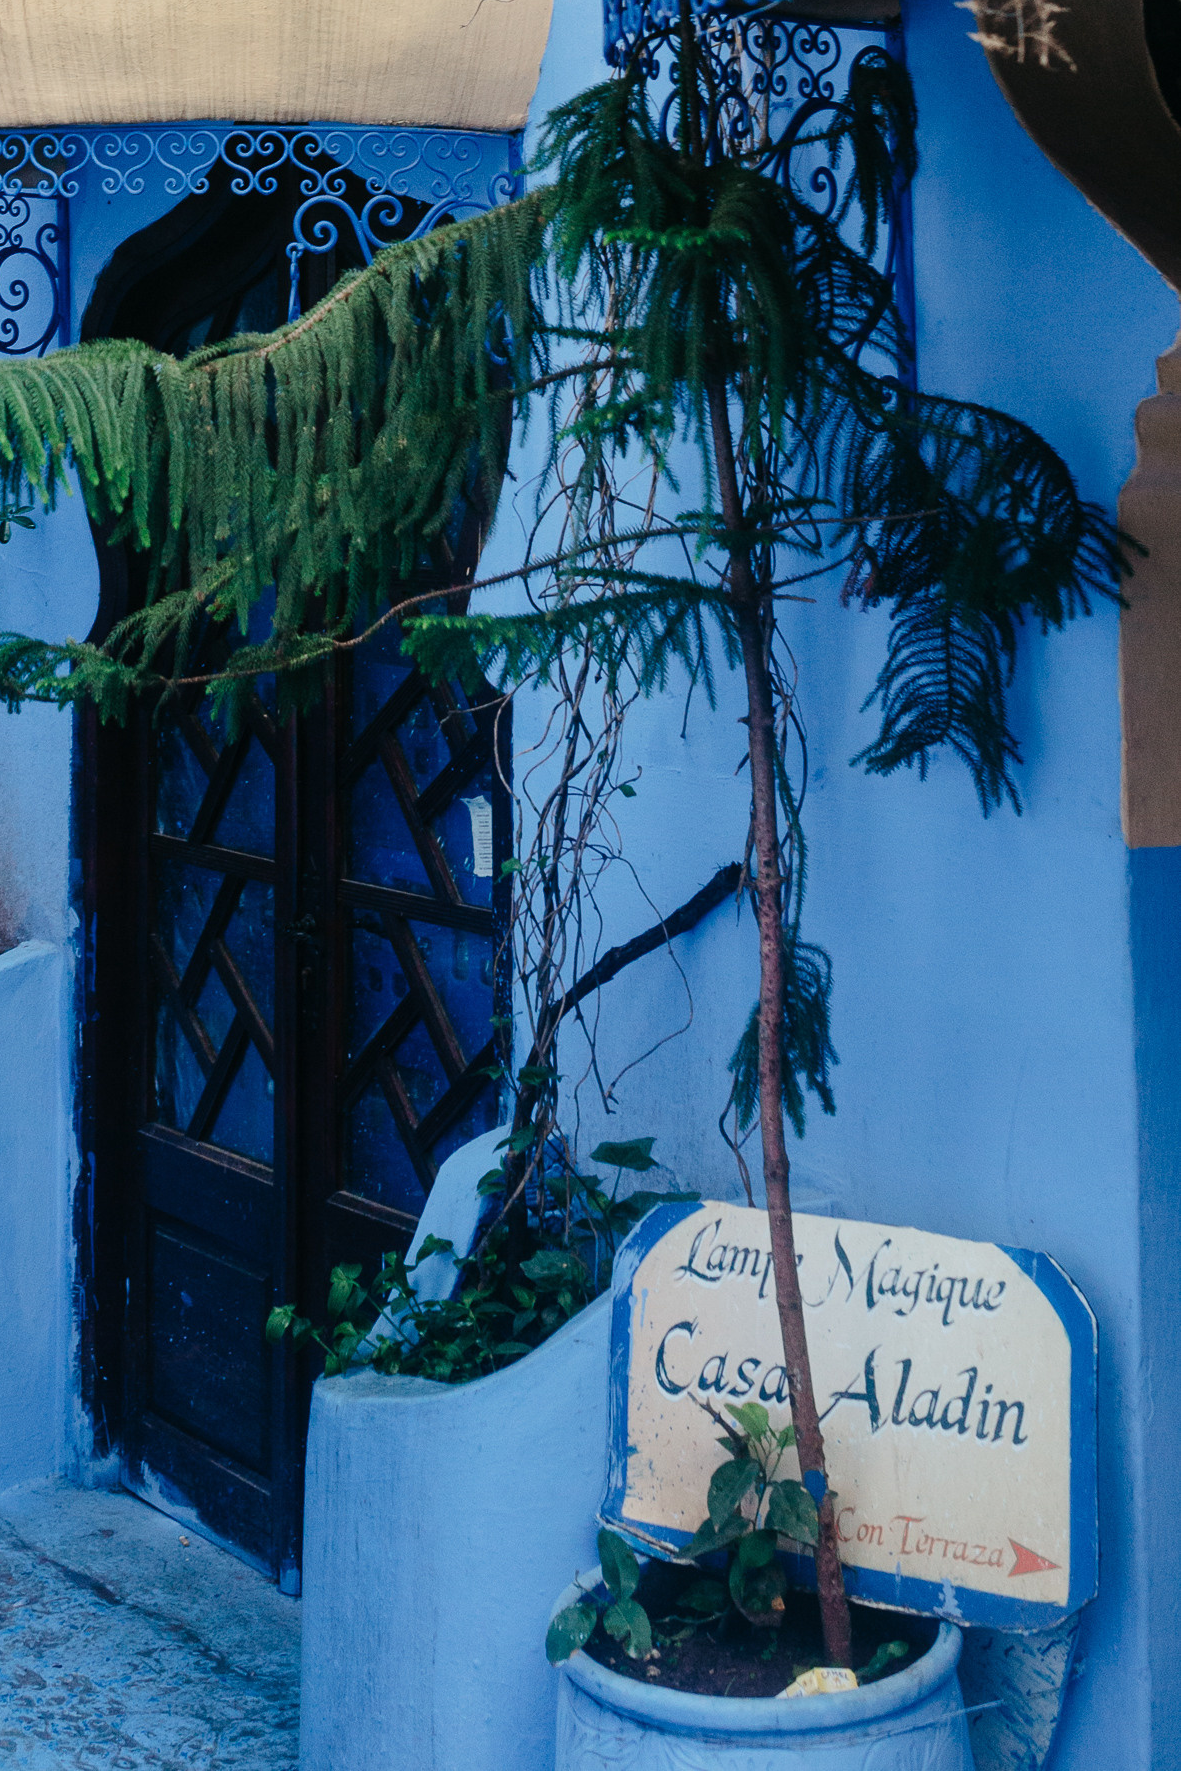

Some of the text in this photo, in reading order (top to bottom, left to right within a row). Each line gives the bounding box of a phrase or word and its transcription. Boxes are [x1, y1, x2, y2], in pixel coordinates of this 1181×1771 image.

[803, 1224, 1006, 1327] Magique
[655, 1316, 1029, 1446] Casa Aladin
[835, 1506, 1005, 1568] Con Terraza
[821, 1670, 849, 1680] CAMEL
